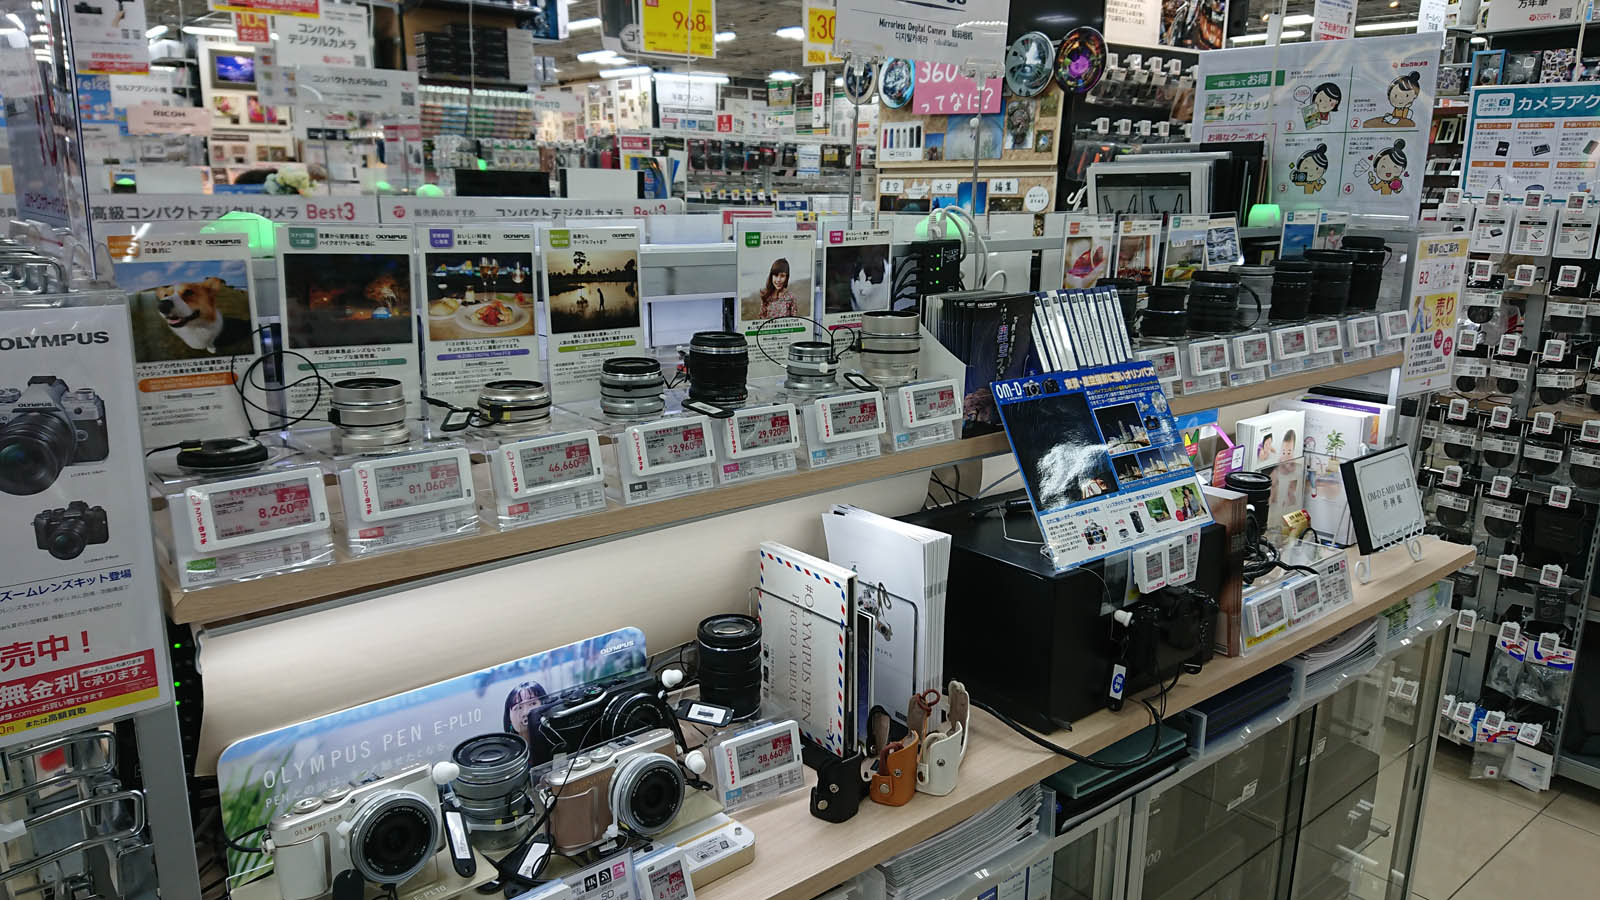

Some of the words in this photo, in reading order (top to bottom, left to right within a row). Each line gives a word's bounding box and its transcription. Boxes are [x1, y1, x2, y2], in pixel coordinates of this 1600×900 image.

[297, 24, 344, 36] コンパクト
[672, 11, 706, 33] 968
[879, 18, 906, 30] Mirrorless
[927, 26, 947, 36] Camera
[288, 34, 357, 50] デジタルカメラ
[1230, 92, 1254, 102] フォト
[153, 110, 187, 118] RICOH
[306, 202, 355, 221] Best3
[1418, 271, 1430, 285] B2
[1434, 297, 1455, 316] 売り
[0, 329, 109, 351] OLYMPUS
[995, 383, 1023, 399] OM-D
[758, 428, 781, 439] 29,920
[667, 442, 694, 454] 32,960
[549, 459, 579, 473] 46,660
[408, 480, 446, 495] 81,060
[258, 503, 295, 519] 8,260
[0, 568, 132, 601] ズームレンズキット登場
[600, 640, 634, 655] OLYMPUS
[788, 655, 798, 703] ALBUM
[801, 689, 812, 726] PEN
[25, 706, 87, 729] または高額買取
[263, 740, 371, 790] OLYMPUS
[382, 724, 422, 750] PEN
[434, 708, 482, 736] E-PL10
[757, 749, 783, 764] 38,660
[294, 818, 328, 836] OLYMPUS
[585, 877, 597, 889] 4K
